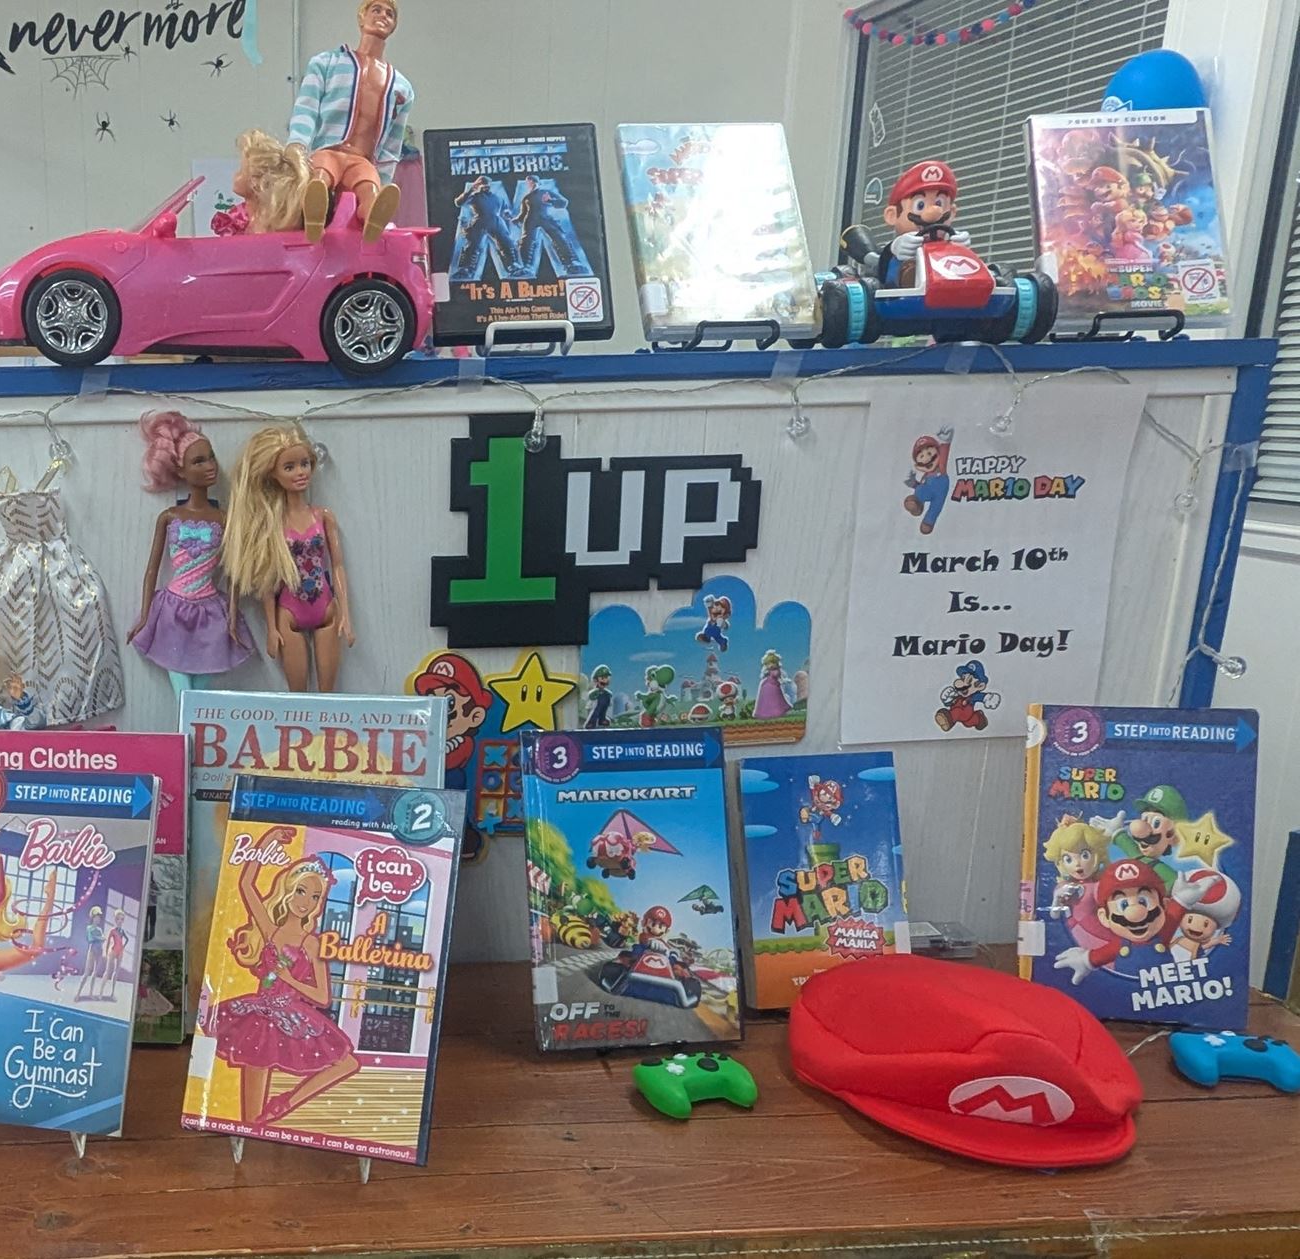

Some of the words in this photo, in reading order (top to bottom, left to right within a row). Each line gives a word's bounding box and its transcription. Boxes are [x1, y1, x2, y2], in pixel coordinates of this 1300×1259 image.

[9, 0, 244, 54] nevermore
[1067, 117, 1103, 126] POWER
[1124, 115, 1167, 124] EDITION
[450, 156, 510, 176] MARIO
[513, 153, 569, 173] BROS.
[501, 282, 513, 299] A
[955, 455, 1027, 475] HAPPY
[1033, 474, 1086, 499] DAY
[450, 437, 556, 604] 1
[565, 467, 741, 566] UP
[899, 549, 999, 575] March
[1012, 547, 1069, 571] 10th
[947, 591, 1012, 613] Is...
[892, 633, 986, 657] Mario
[996, 629, 1074, 658] Day!
[194, 707, 225, 720] THE
[230, 708, 278, 722] GOOD,
[283, 710, 313, 723] THE
[319, 712, 354, 725] BAD,
[359, 713, 392, 725] AND
[1071, 721, 1088, 743] 3
[1114, 724, 1148, 737] STEP
[1149, 727, 1171, 737] INTO
[1172, 726, 1236, 740] READING
[30, 747, 118, 770] Clothes
[190, 722, 427, 777] BARBIE
[552, 746, 568, 769] 3
[592, 745, 623, 760] STEP
[625, 746, 645, 757] INTO
[646, 743, 703, 758] READING
[202, 771, 232, 782] Doll's
[1059, 766, 1118, 783] SUPER
[15, 785, 47, 799] STEP
[49, 788, 70, 798] INTO
[71, 788, 133, 804] READING
[1047, 780, 1125, 802] MARIO
[241, 791, 274, 809] STEP
[277, 796, 299, 807] INTO
[300, 796, 366, 815] READING
[331, 819, 360, 829] reading
[362, 819, 380, 829] with
[381, 820, 399, 831] help
[411, 803, 432, 831] 2
[20, 817, 115, 871] Barbie
[229, 834, 290, 866] Barbie
[367, 854, 374, 871] i
[376, 859, 414, 876] can
[777, 854, 872, 898] SUPER
[770, 879, 890, 935] MARIO
[368, 911, 387, 937] A
[834, 927, 879, 940] MANGA
[319, 932, 433, 971] Ballerina
[834, 937, 877, 950] MANIA
[1139, 958, 1210, 988] MEET
[1131, 976, 1234, 1012] MARIO!
[549, 1001, 600, 1021] OFF
[24, 1009, 45, 1033] I
[49, 1018, 85, 1044] Can
[553, 1018, 648, 1041] RACES!
[33, 1038, 54, 1061] Be
[63, 1048, 77, 1063] a
[4, 1047, 102, 1109] Gymnast
[218, 1121, 235, 1131] rock
[265, 1130, 279, 1138] can
[281, 1131, 292, 1141] be
[327, 1139, 342, 1148] can
[344, 1140, 354, 1150] be
